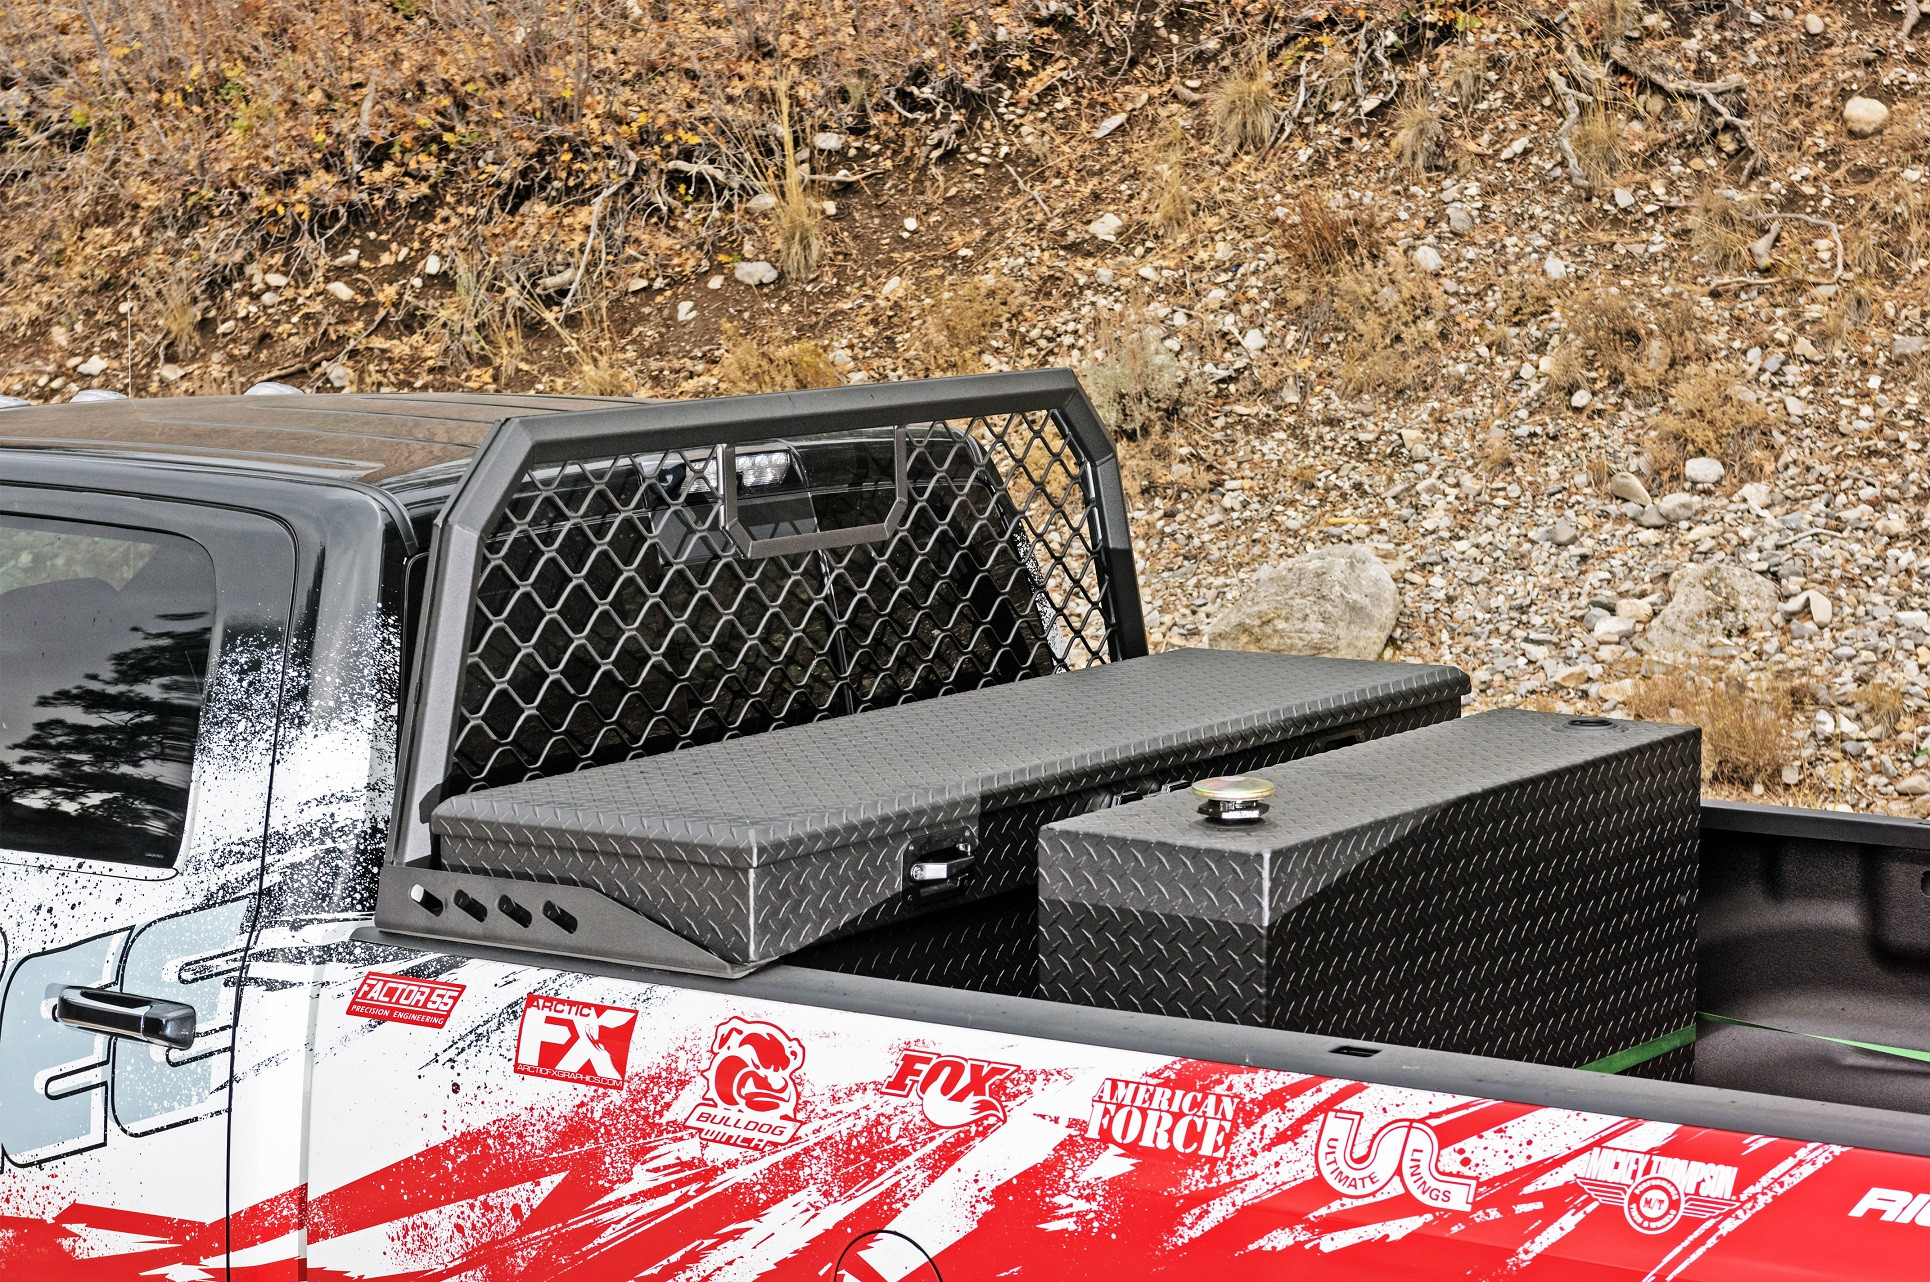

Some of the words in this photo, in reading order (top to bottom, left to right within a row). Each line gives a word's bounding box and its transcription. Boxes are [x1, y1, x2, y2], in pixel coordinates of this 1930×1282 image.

[351, 1004, 389, 1017] PRECISION
[392, 1011, 444, 1025] ENGINEERING
[357, 978, 425, 1006] FACTOR
[428, 988, 458, 1011] 55
[530, 999, 595, 1018] ARCTIC
[517, 1009, 636, 1081] FX
[516, 1063, 622, 1087] ARCTICFXGRAPHICS.COM
[884, 1051, 1018, 1102] FOX
[1094, 1079, 1239, 1120] AMERICAN
[696, 1112, 787, 1136] BULLDOG
[1085, 1102, 1232, 1159] FORCE
[1327, 1137, 1380, 1190] ULTIMATE
[1409, 1148, 1452, 1203] LININGS
[1585, 1146, 1650, 1185] MICKEY
